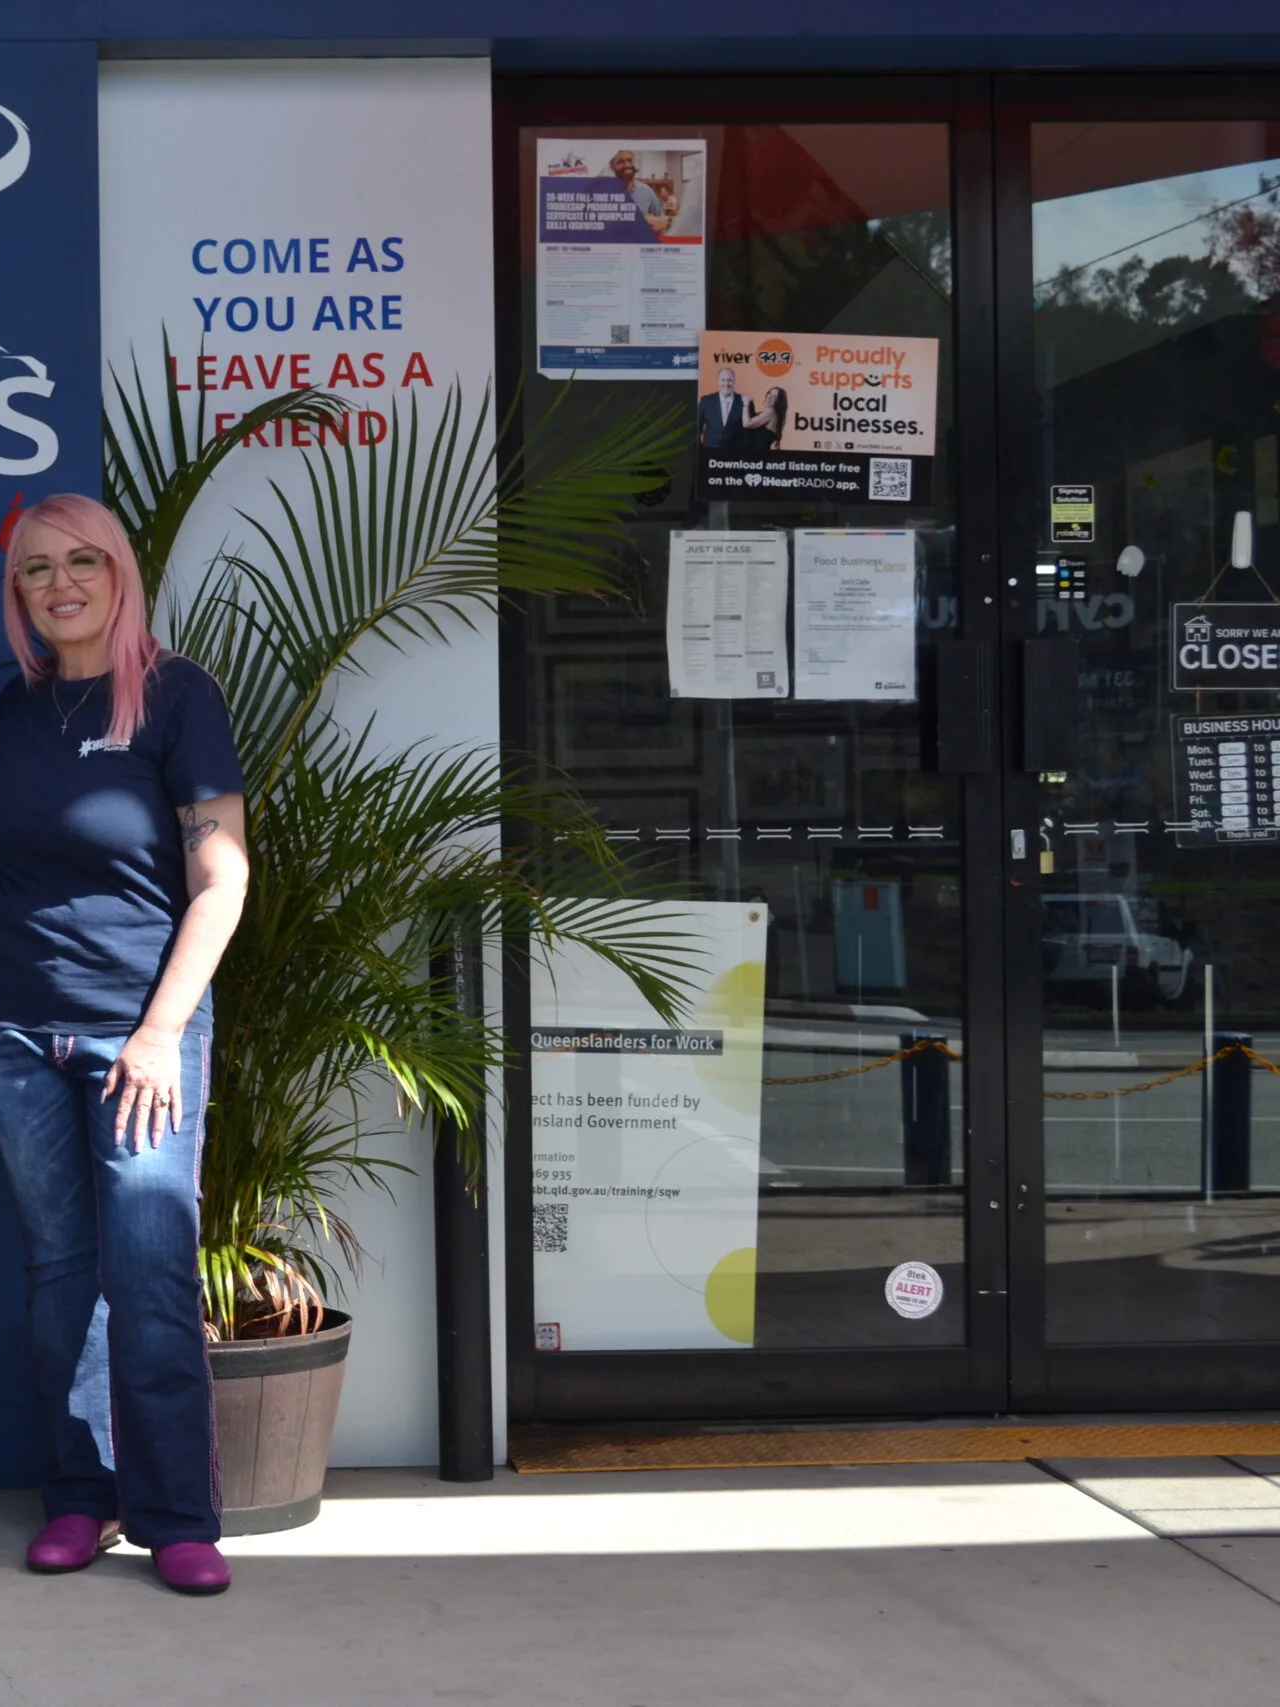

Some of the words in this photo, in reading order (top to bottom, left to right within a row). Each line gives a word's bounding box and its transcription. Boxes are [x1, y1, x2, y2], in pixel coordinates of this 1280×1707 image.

[191, 238, 331, 275] COME
[346, 237, 405, 273] AS
[192, 296, 295, 332] YOU
[311, 295, 403, 331] ARE
[713, 349, 754, 365] river
[758, 351, 793, 366] 94.9
[816, 345, 907, 371] Proudly
[169, 354, 312, 391] LEAVE
[327, 352, 386, 388] AS
[401, 352, 434, 388] A
[833, 392, 888, 413] local
[794, 412, 924, 436] businesses.
[708, 459, 763, 471] Download
[765, 460, 787, 471] and
[788, 461, 818, 472] listen
[820, 462, 836, 473] for
[839, 462, 861, 473] free
[708, 477, 723, 486] on
[725, 475, 743, 486] the
[762, 476, 835, 489] iHeartRADIO
[836, 481, 860, 492] app.
[686, 545, 710, 554] JUST
[713, 545, 724, 554] IN
[726, 545, 752, 554] CASE
[813, 556, 838, 566] Food
[840, 556, 883, 567] Business
[1215, 628, 1250, 638] SORRY
[1251, 628, 1269, 638] WE
[1179, 644, 1280, 670] CLOSE
[1183, 720, 1249, 734] BUSINESS
[1187, 745, 1213, 755] Mon.
[1253, 743, 1265, 752] to
[1188, 757, 1216, 766] Tues.
[1254, 755, 1265, 764] to
[1188, 770, 1216, 779] Wed.
[1255, 769, 1266, 777] to
[1189, 782, 1217, 792] Thur.
[1255, 781, 1267, 789] to
[1189, 795, 1206, 805] Fri.
[1256, 793, 1268, 802] to
[1190, 808, 1211, 818] Sat.
[1257, 806, 1268, 815] to
[1257, 817, 1268, 826] to
[1226, 831, 1249, 839] Thank
[1253, 832, 1269, 840] you
[530, 1032, 647, 1049] Queenslanders
[650, 1033, 672, 1049] for
[675, 1036, 715, 1050] Work
[531, 1093, 553, 1106] ect
[557, 1092, 583, 1106] has
[587, 1093, 623, 1107] been
[628, 1093, 678, 1108] funded
[683, 1094, 701, 1111] by
[533, 1113, 583, 1128] nsland
[587, 1114, 677, 1130] Government
[533, 1151, 575, 1162] rmation
[532, 1168, 550, 1181] 69
[552, 1170, 572, 1181] 935
[895, 1282, 933, 1297] ALERT
